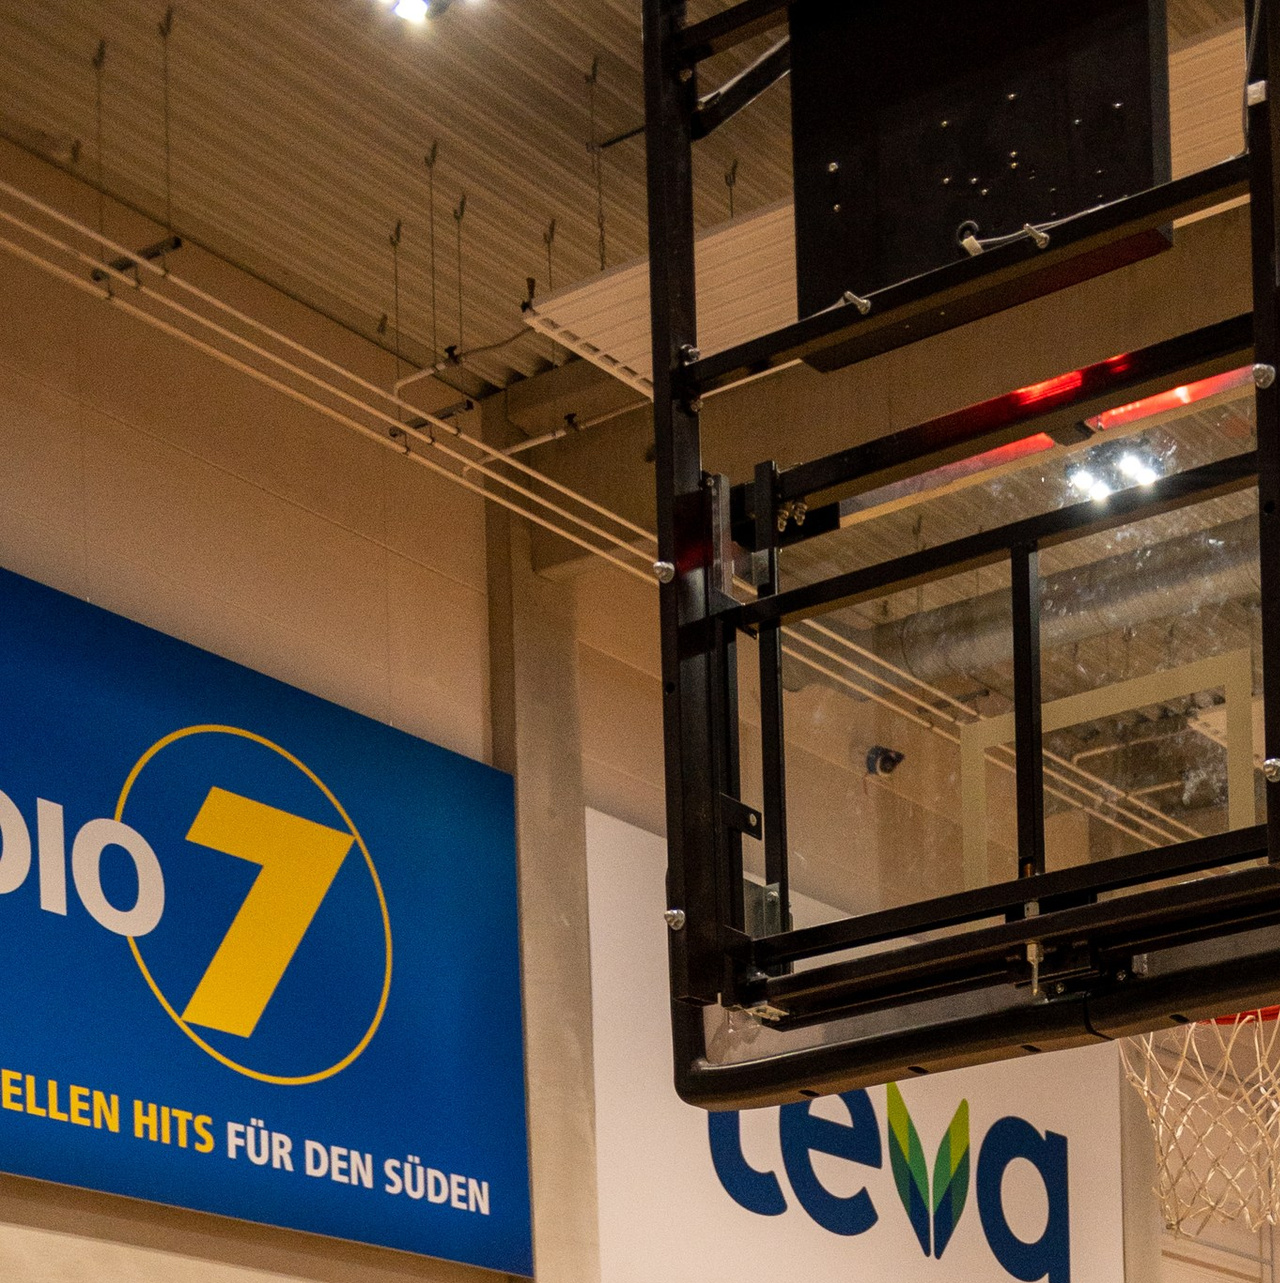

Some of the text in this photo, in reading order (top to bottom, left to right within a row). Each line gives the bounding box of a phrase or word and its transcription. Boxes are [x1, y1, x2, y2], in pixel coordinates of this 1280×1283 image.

[182, 786, 356, 1039] 7
[0, 1070, 490, 1216] ELLEN HITS FÜR DEN SÜDEN
